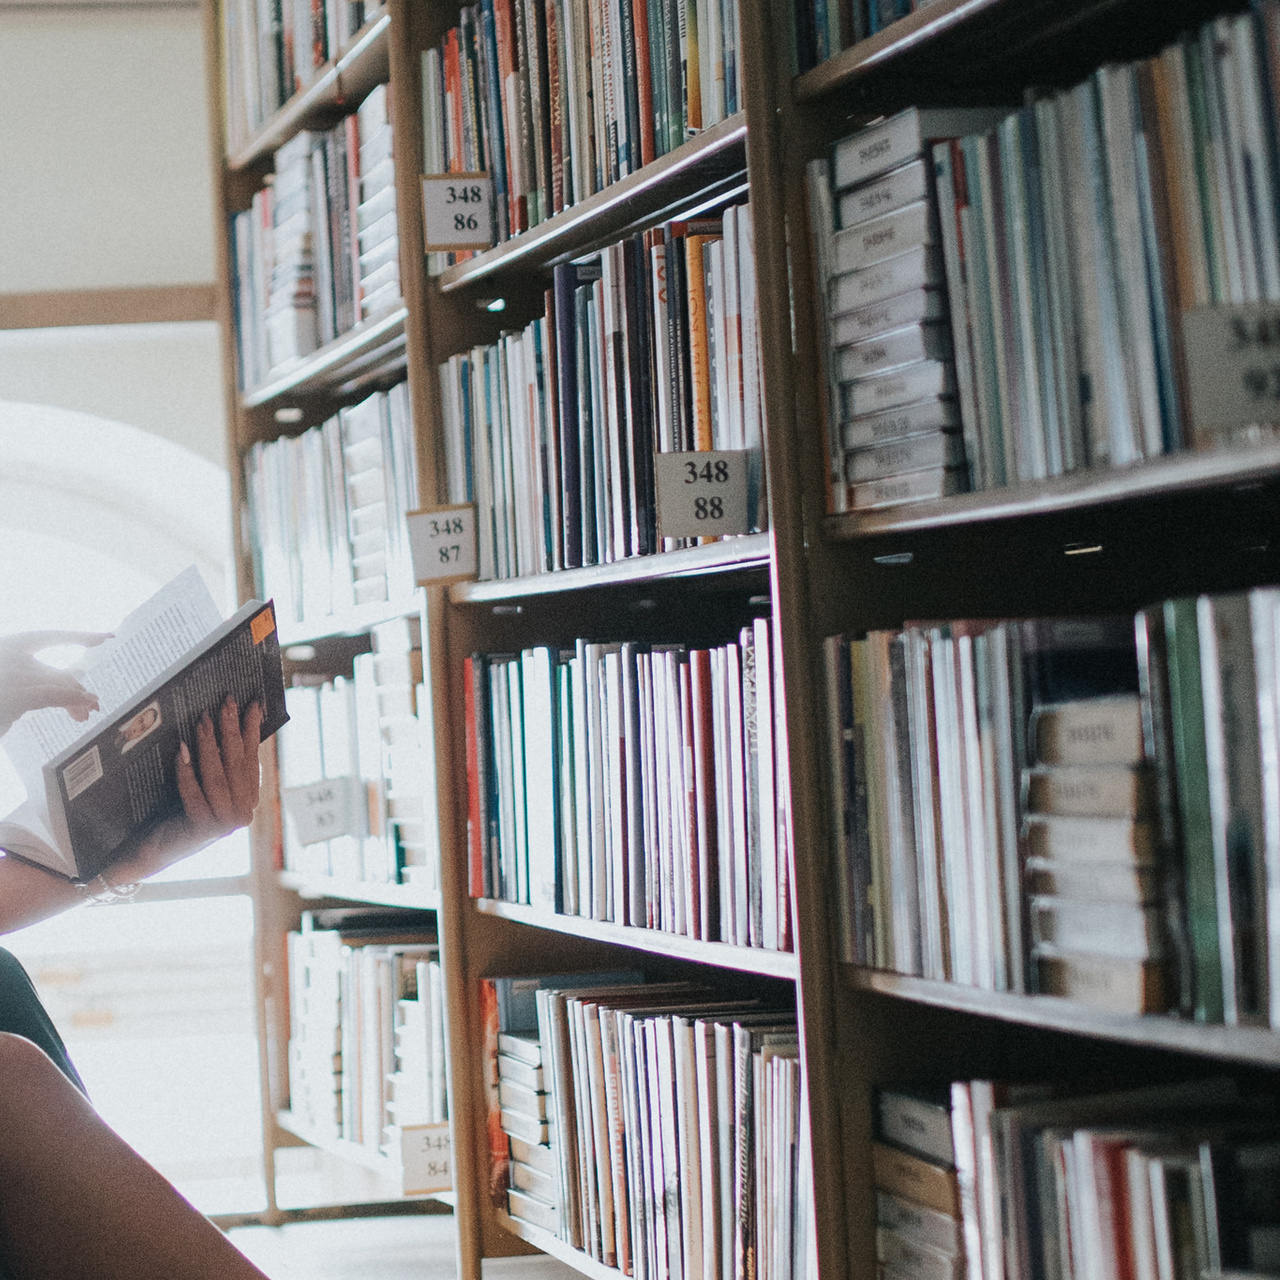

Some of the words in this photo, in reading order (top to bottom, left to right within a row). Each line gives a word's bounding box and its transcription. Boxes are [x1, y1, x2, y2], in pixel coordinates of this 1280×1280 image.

[446, 185, 482, 206] 348
[453, 213, 478, 232] 86
[684, 460, 729, 485] 348
[694, 495, 724, 521] 88
[429, 517, 463, 538] 348
[438, 545, 461, 564] 87
[427, 1161, 448, 1177] 84
